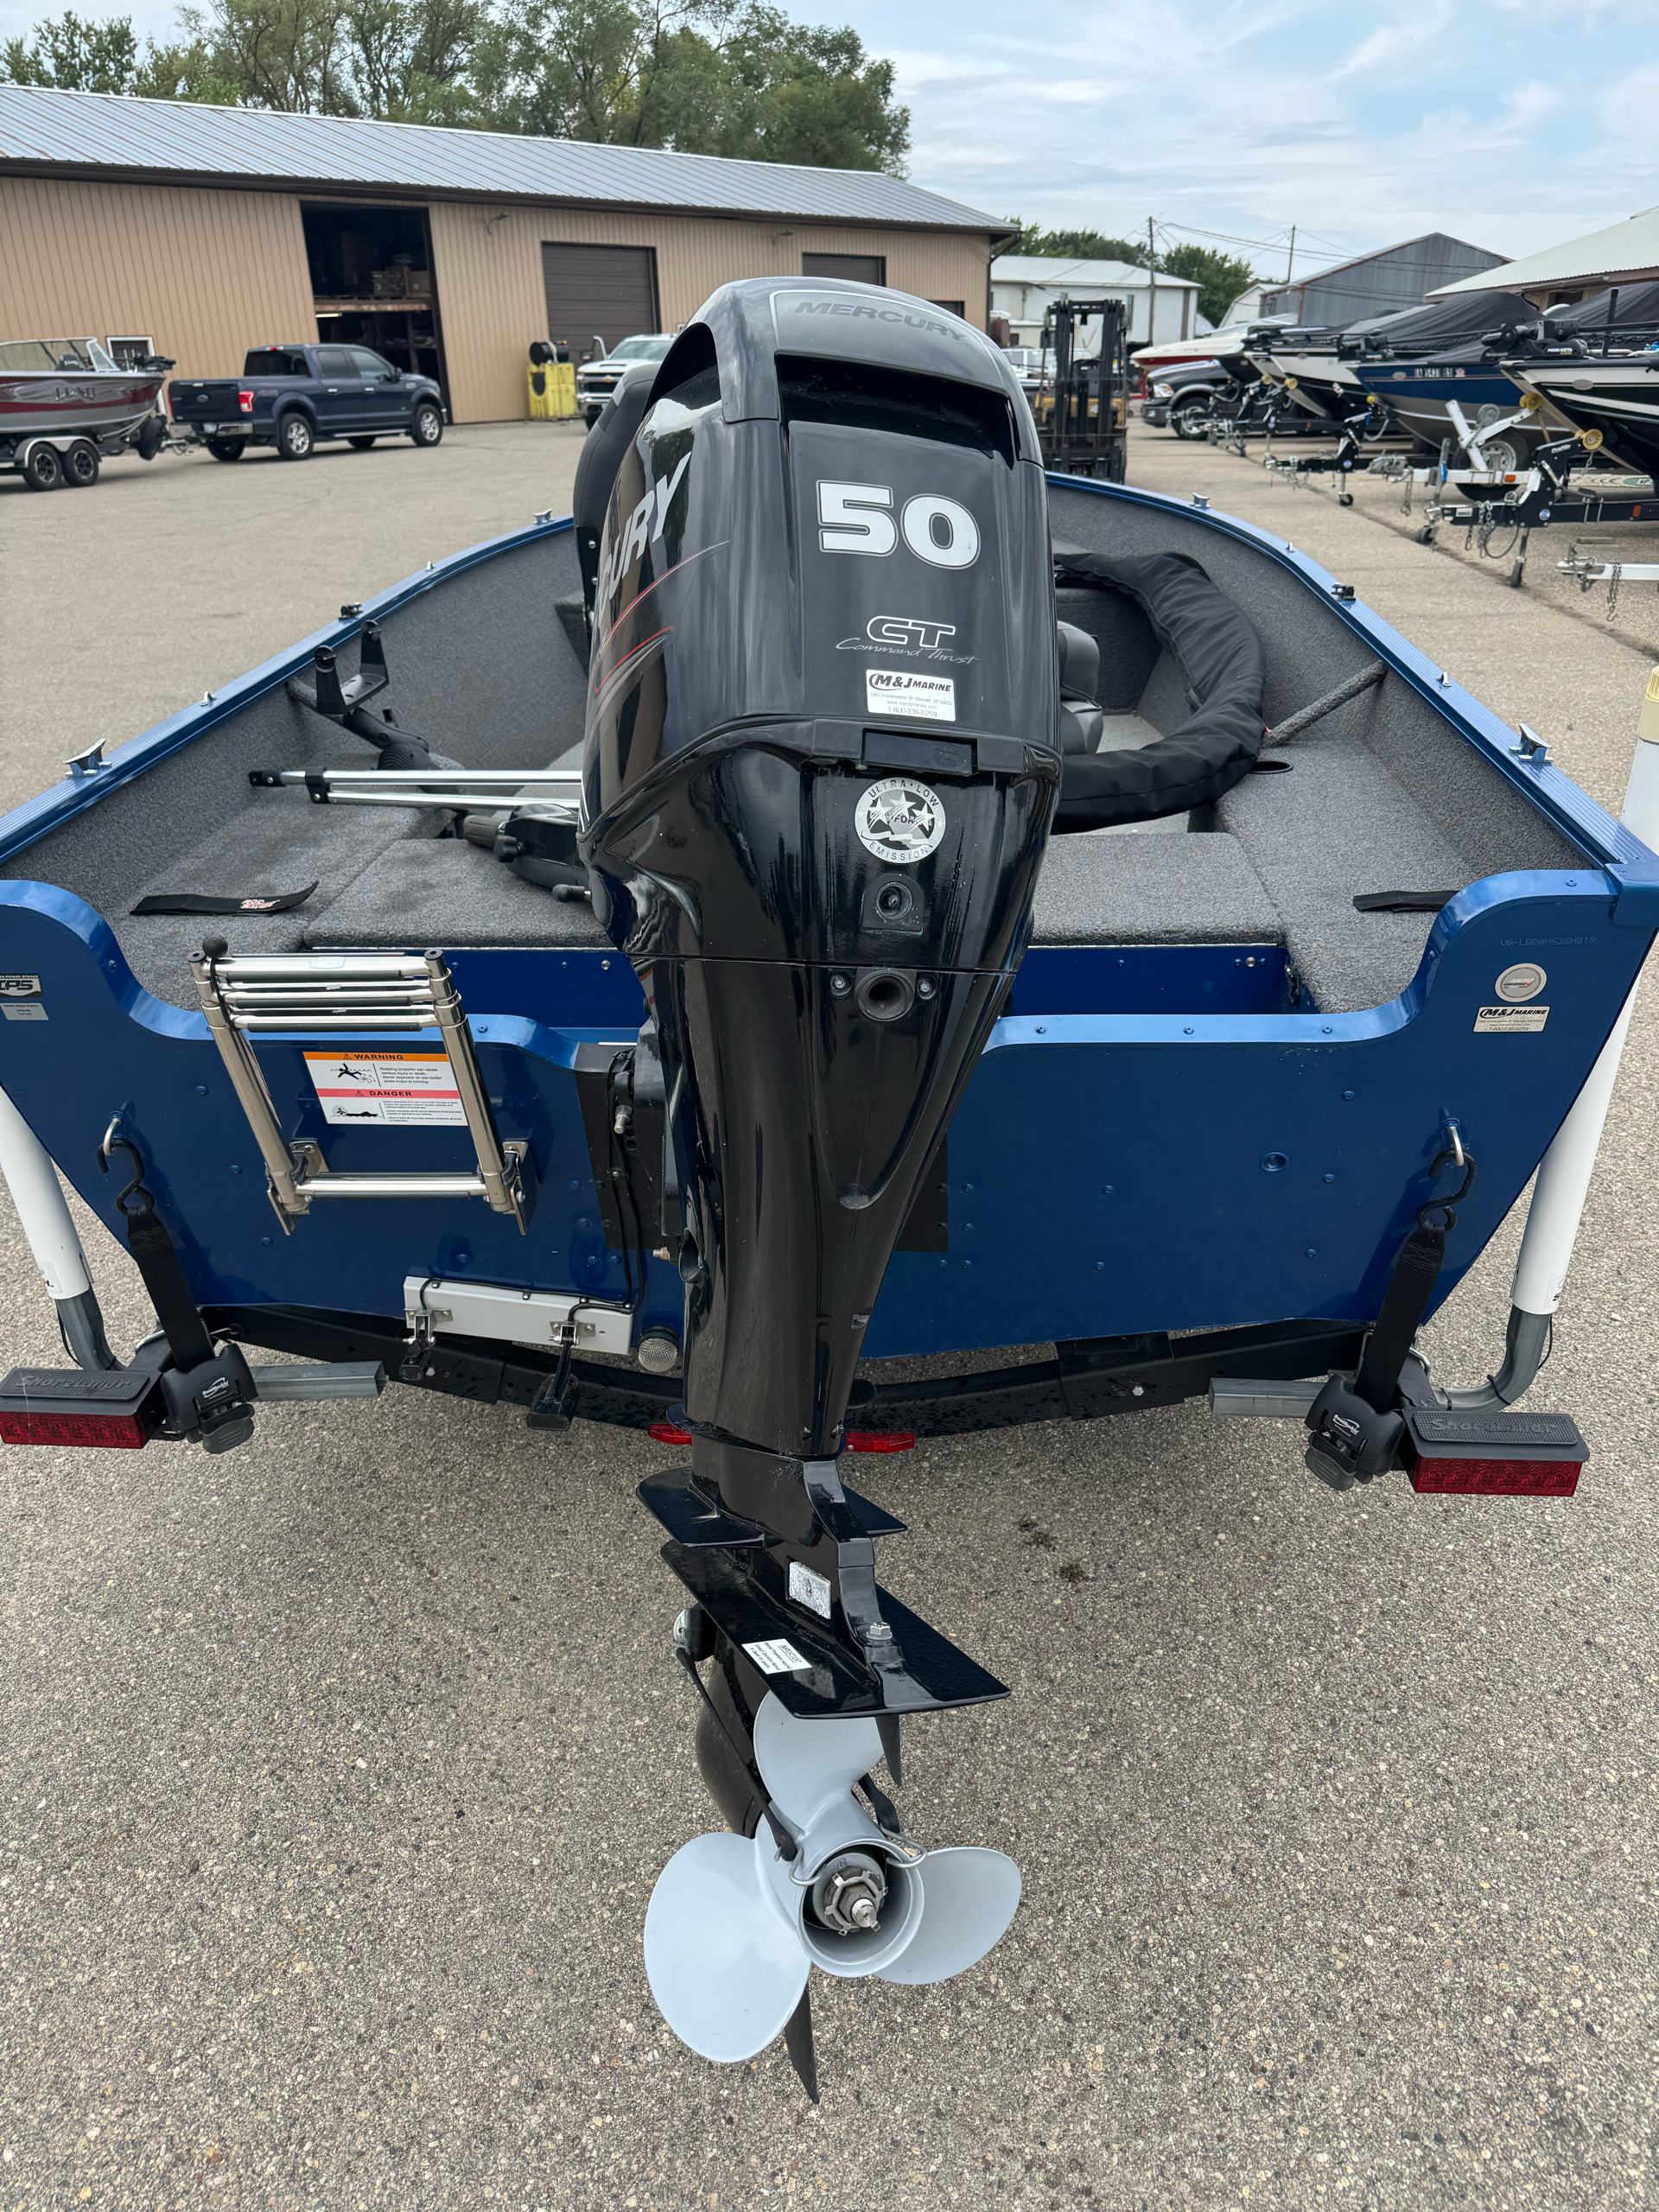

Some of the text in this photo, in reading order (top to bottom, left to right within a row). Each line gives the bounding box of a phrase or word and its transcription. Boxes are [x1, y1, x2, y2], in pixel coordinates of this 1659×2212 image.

[794, 302, 969, 340] MERCURY
[816, 480, 982, 570] 50
[836, 638, 981, 664] Command Thrust
[912, 680, 951, 692] MARINE
[868, 779, 939, 807] ULTRA LOW
[869, 842, 929, 861] EMISSION
